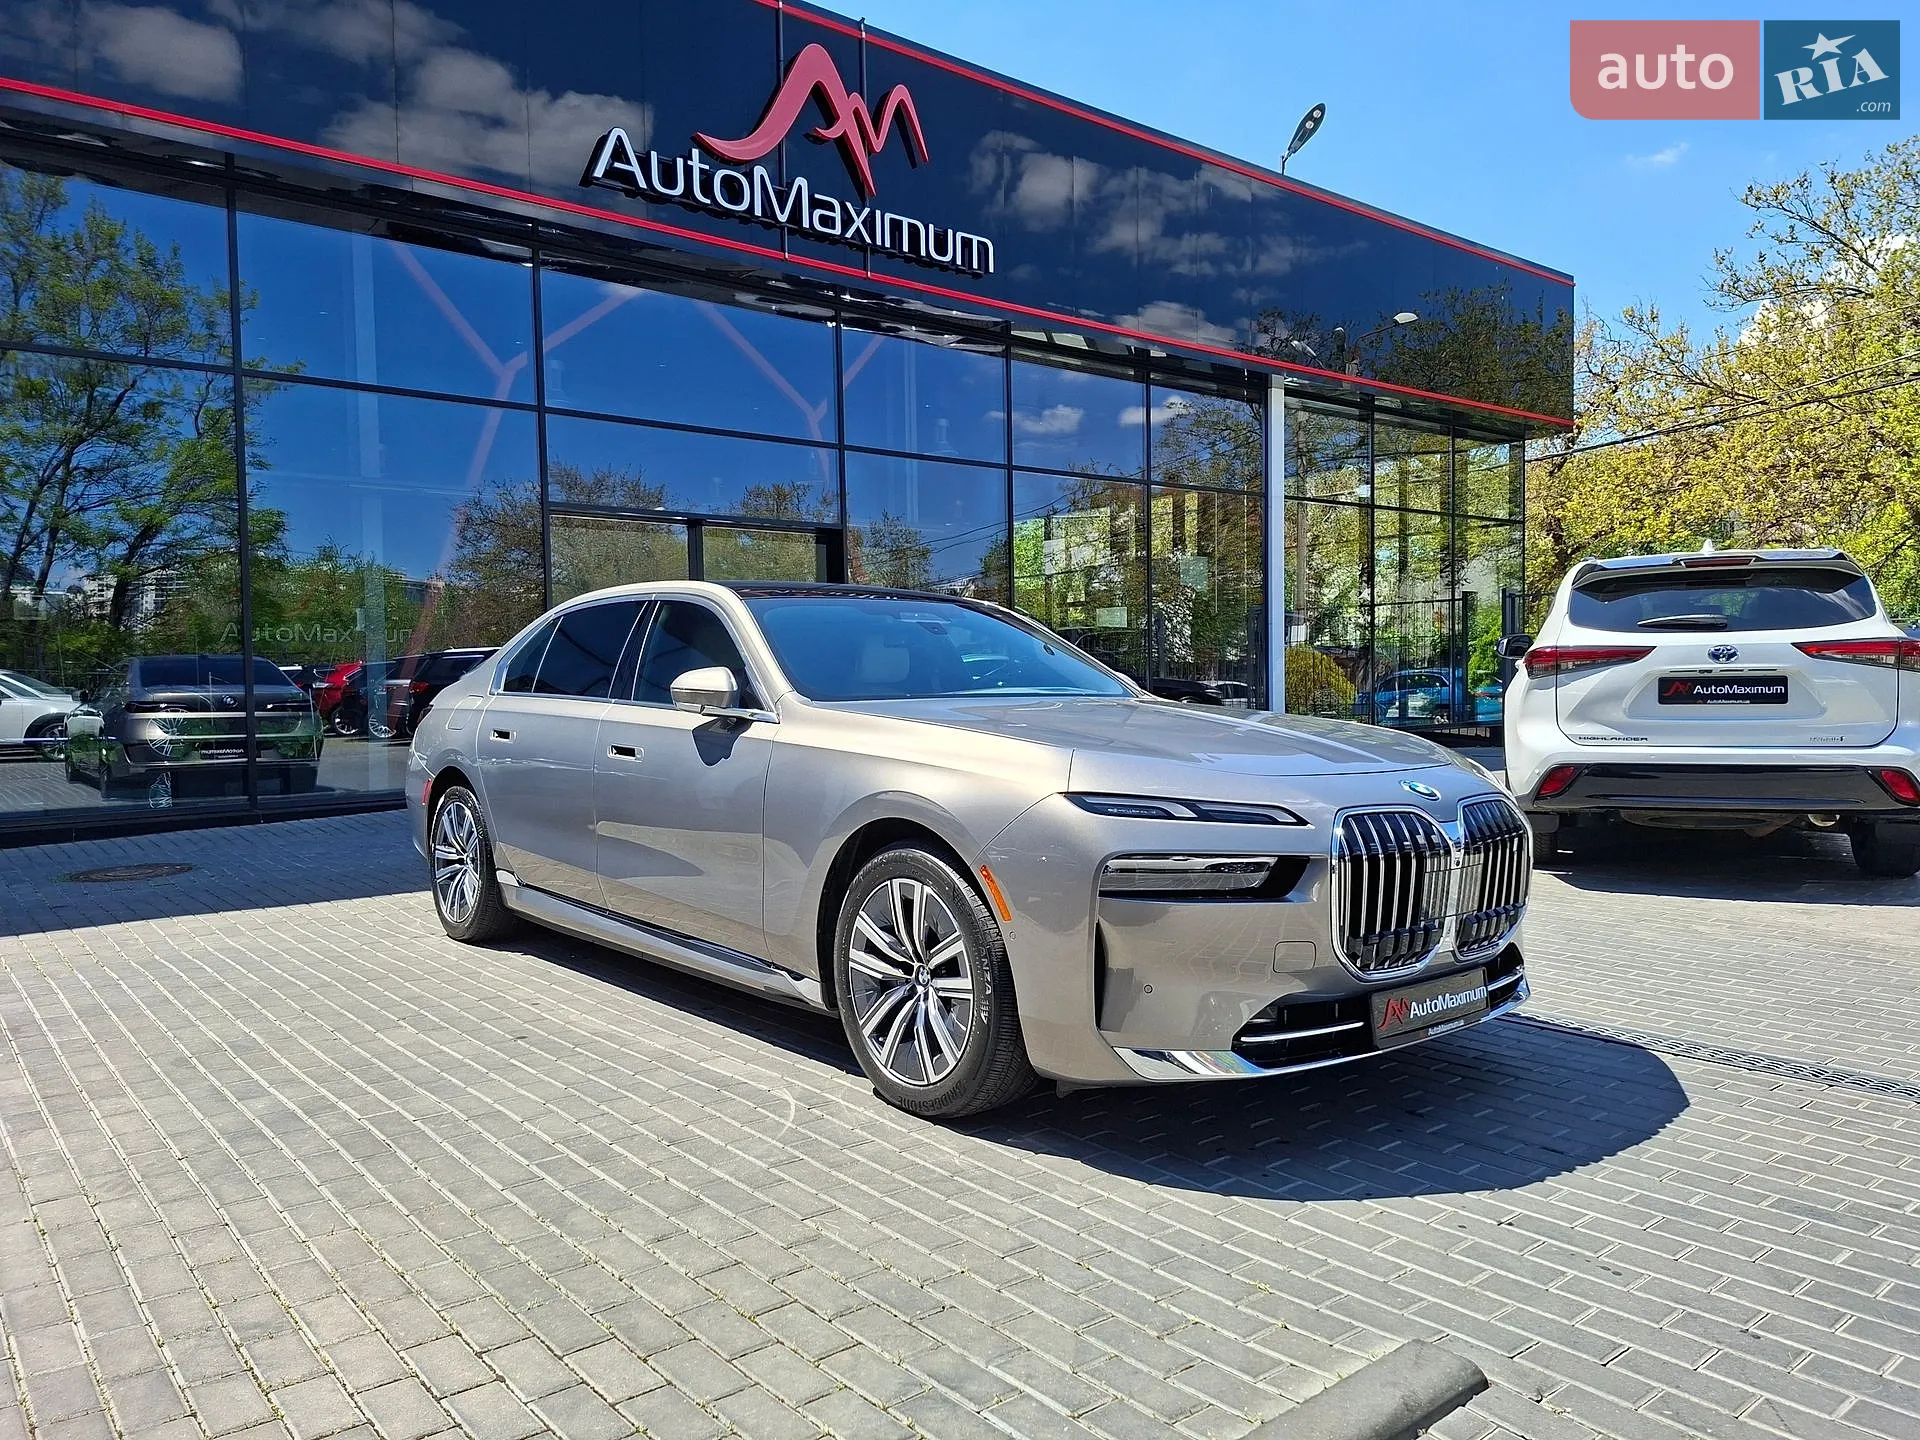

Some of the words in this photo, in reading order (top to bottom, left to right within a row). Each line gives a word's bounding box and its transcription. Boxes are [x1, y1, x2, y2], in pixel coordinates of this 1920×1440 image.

[592, 127, 995, 273] AutoMaximum
[1693, 684, 1784, 694] AutoMaximum
[1410, 985, 1487, 1019] AutoMaximum
